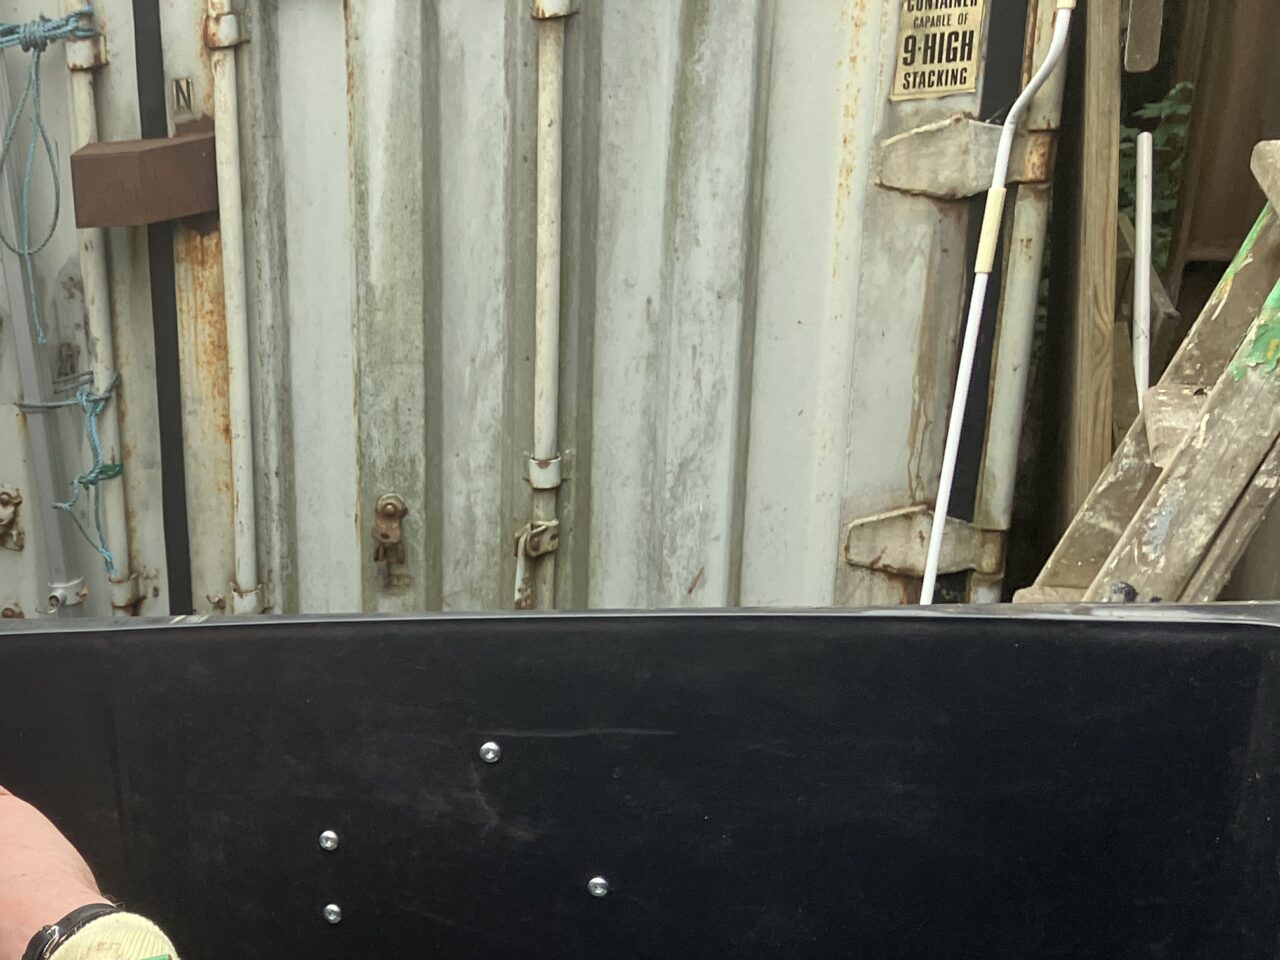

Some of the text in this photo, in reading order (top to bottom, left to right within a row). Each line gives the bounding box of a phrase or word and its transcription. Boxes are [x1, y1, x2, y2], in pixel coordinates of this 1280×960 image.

[913, 12, 969, 29] CAPABLE OF
[903, 67, 968, 90] STACKING
[174, 78, 192, 112] N
